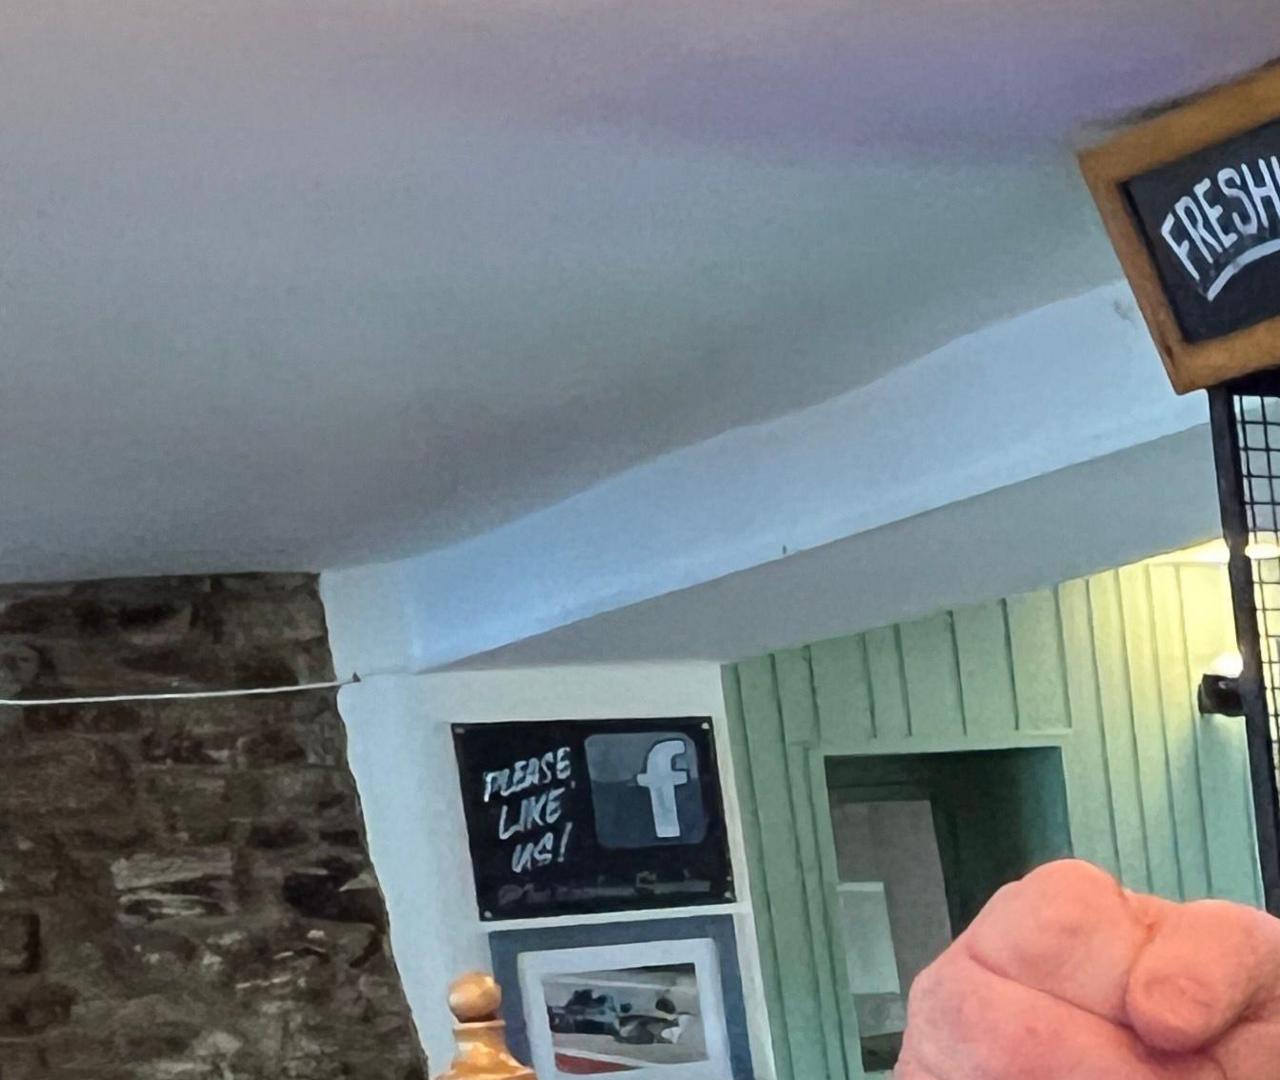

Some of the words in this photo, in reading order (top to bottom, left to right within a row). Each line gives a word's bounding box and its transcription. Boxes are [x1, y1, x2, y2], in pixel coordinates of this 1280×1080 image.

[484, 746, 571, 803] PLEASE
[498, 787, 566, 840] LIKE
[511, 821, 574, 873] US!
